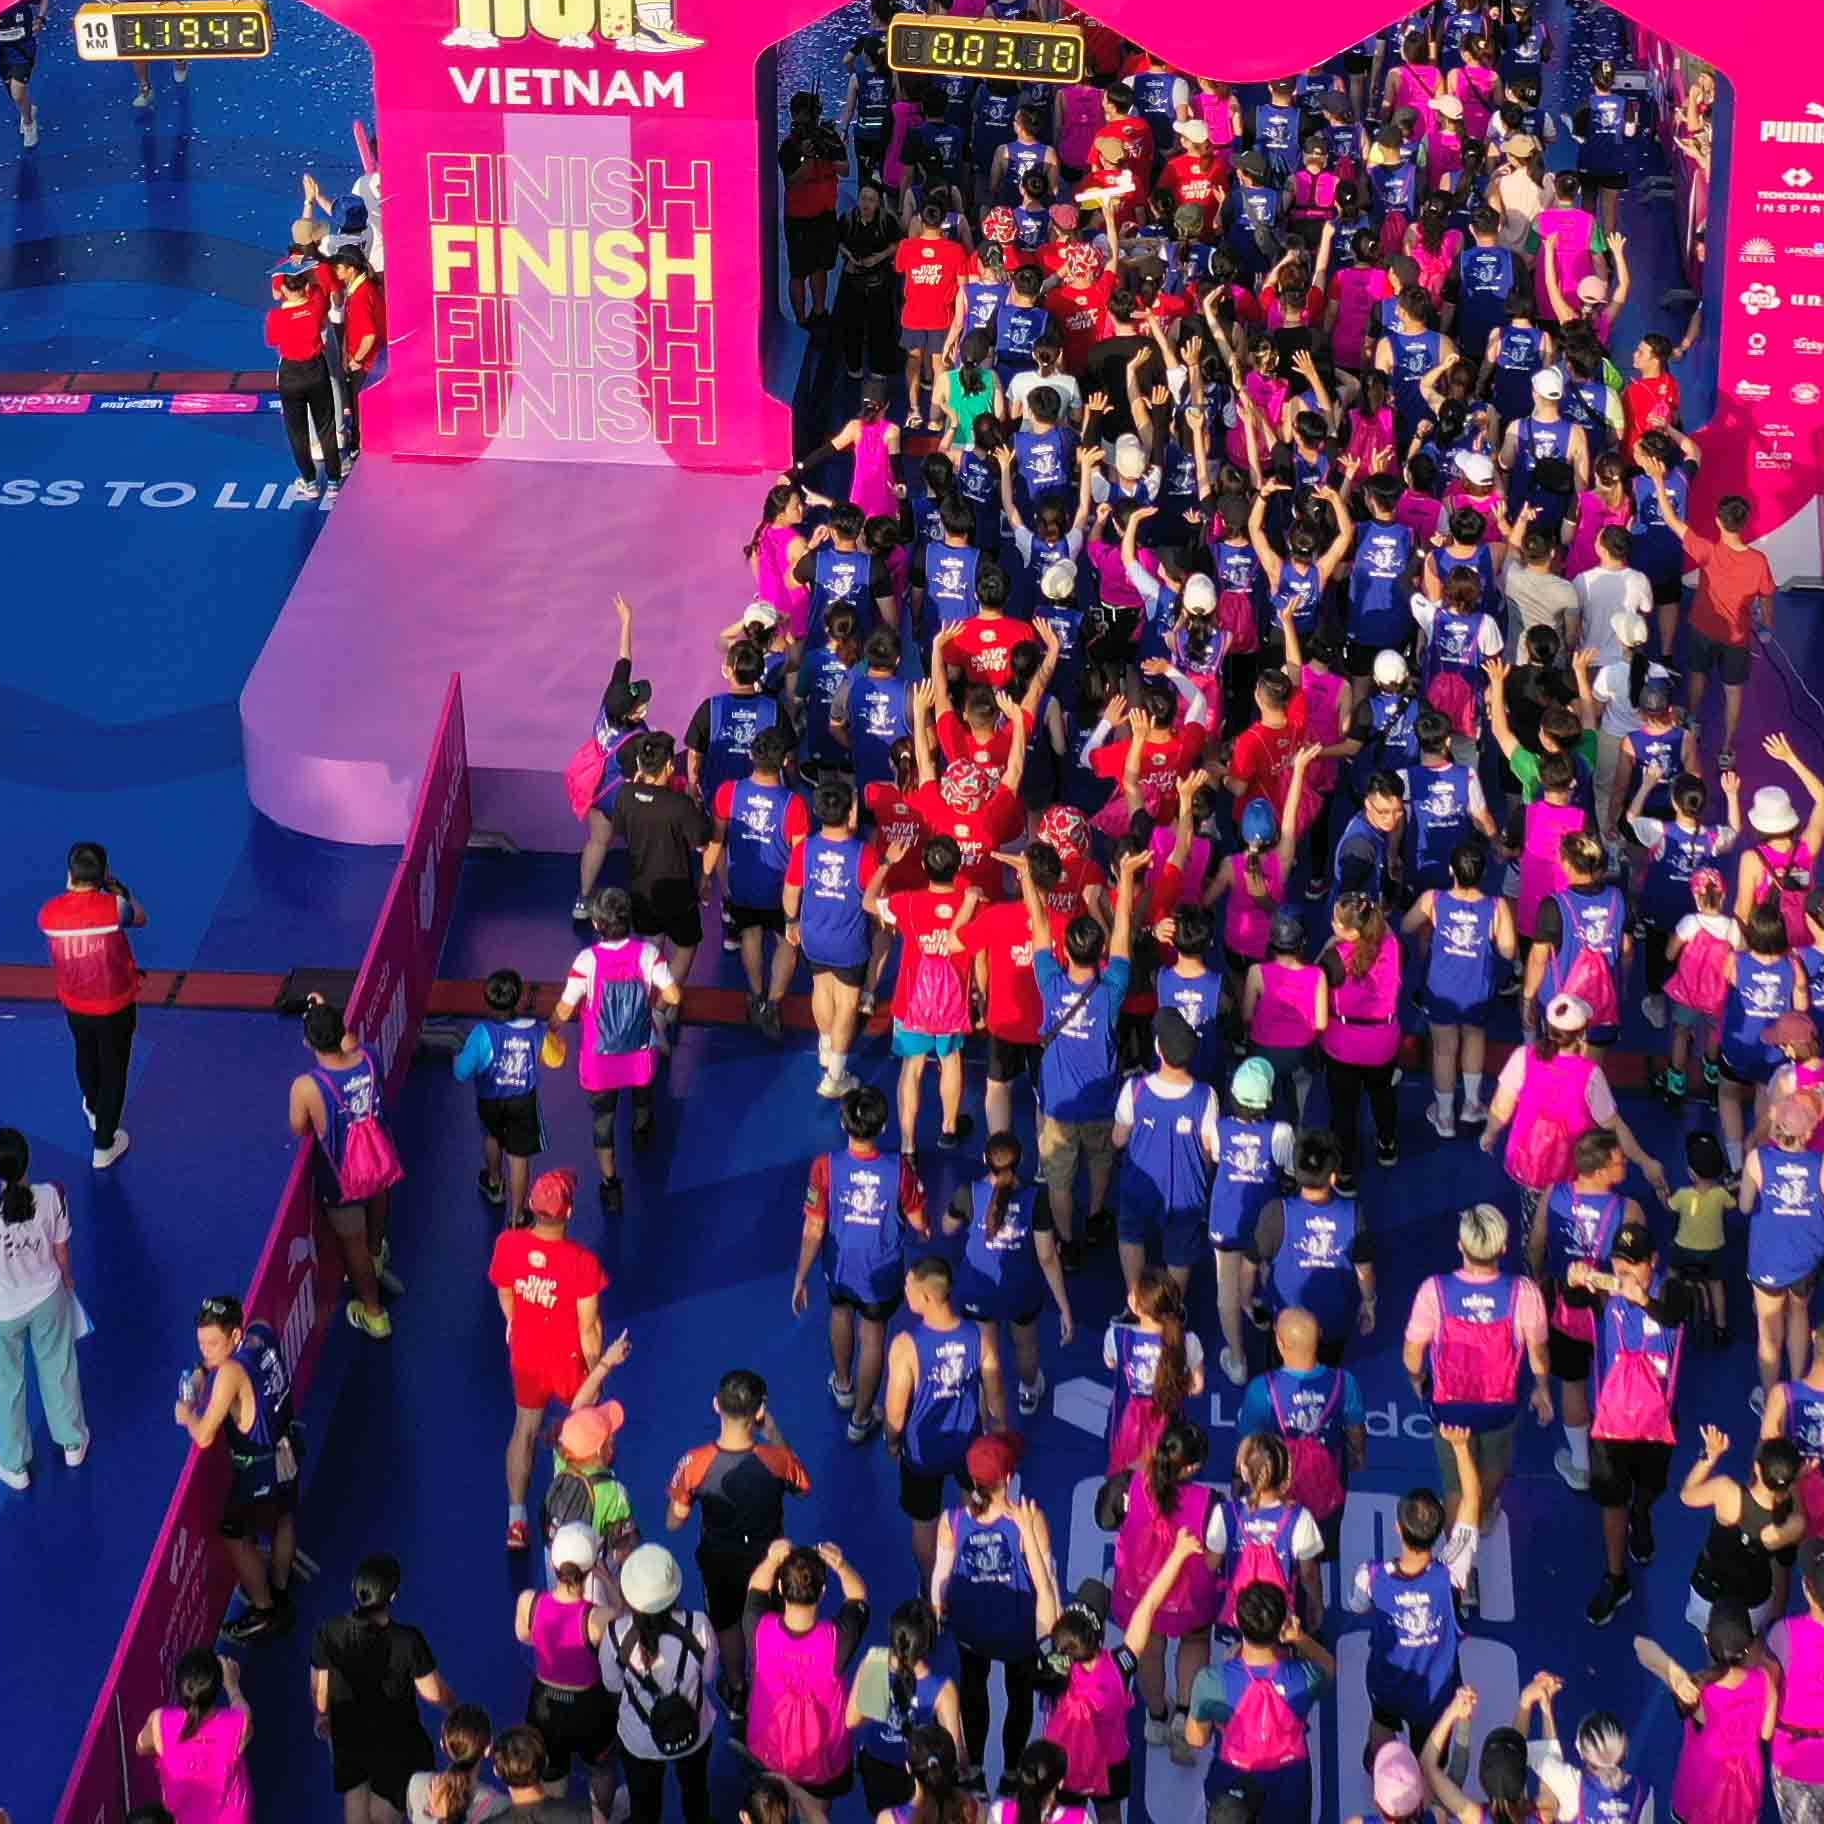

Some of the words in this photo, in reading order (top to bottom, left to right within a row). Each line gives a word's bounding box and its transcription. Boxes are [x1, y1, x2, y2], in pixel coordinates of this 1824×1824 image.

[82, 22, 108, 38] 10
[86, 39, 109, 49] KM
[448, 67, 685, 108] VIETNAM
[427, 152, 712, 231] FINISH
[431, 224, 713, 301] FINISH
[433, 295, 715, 372] FINISH
[437, 369, 716, 445] FINISH
[103, 480, 197, 508] TO
[214, 482, 335, 510] LIF
